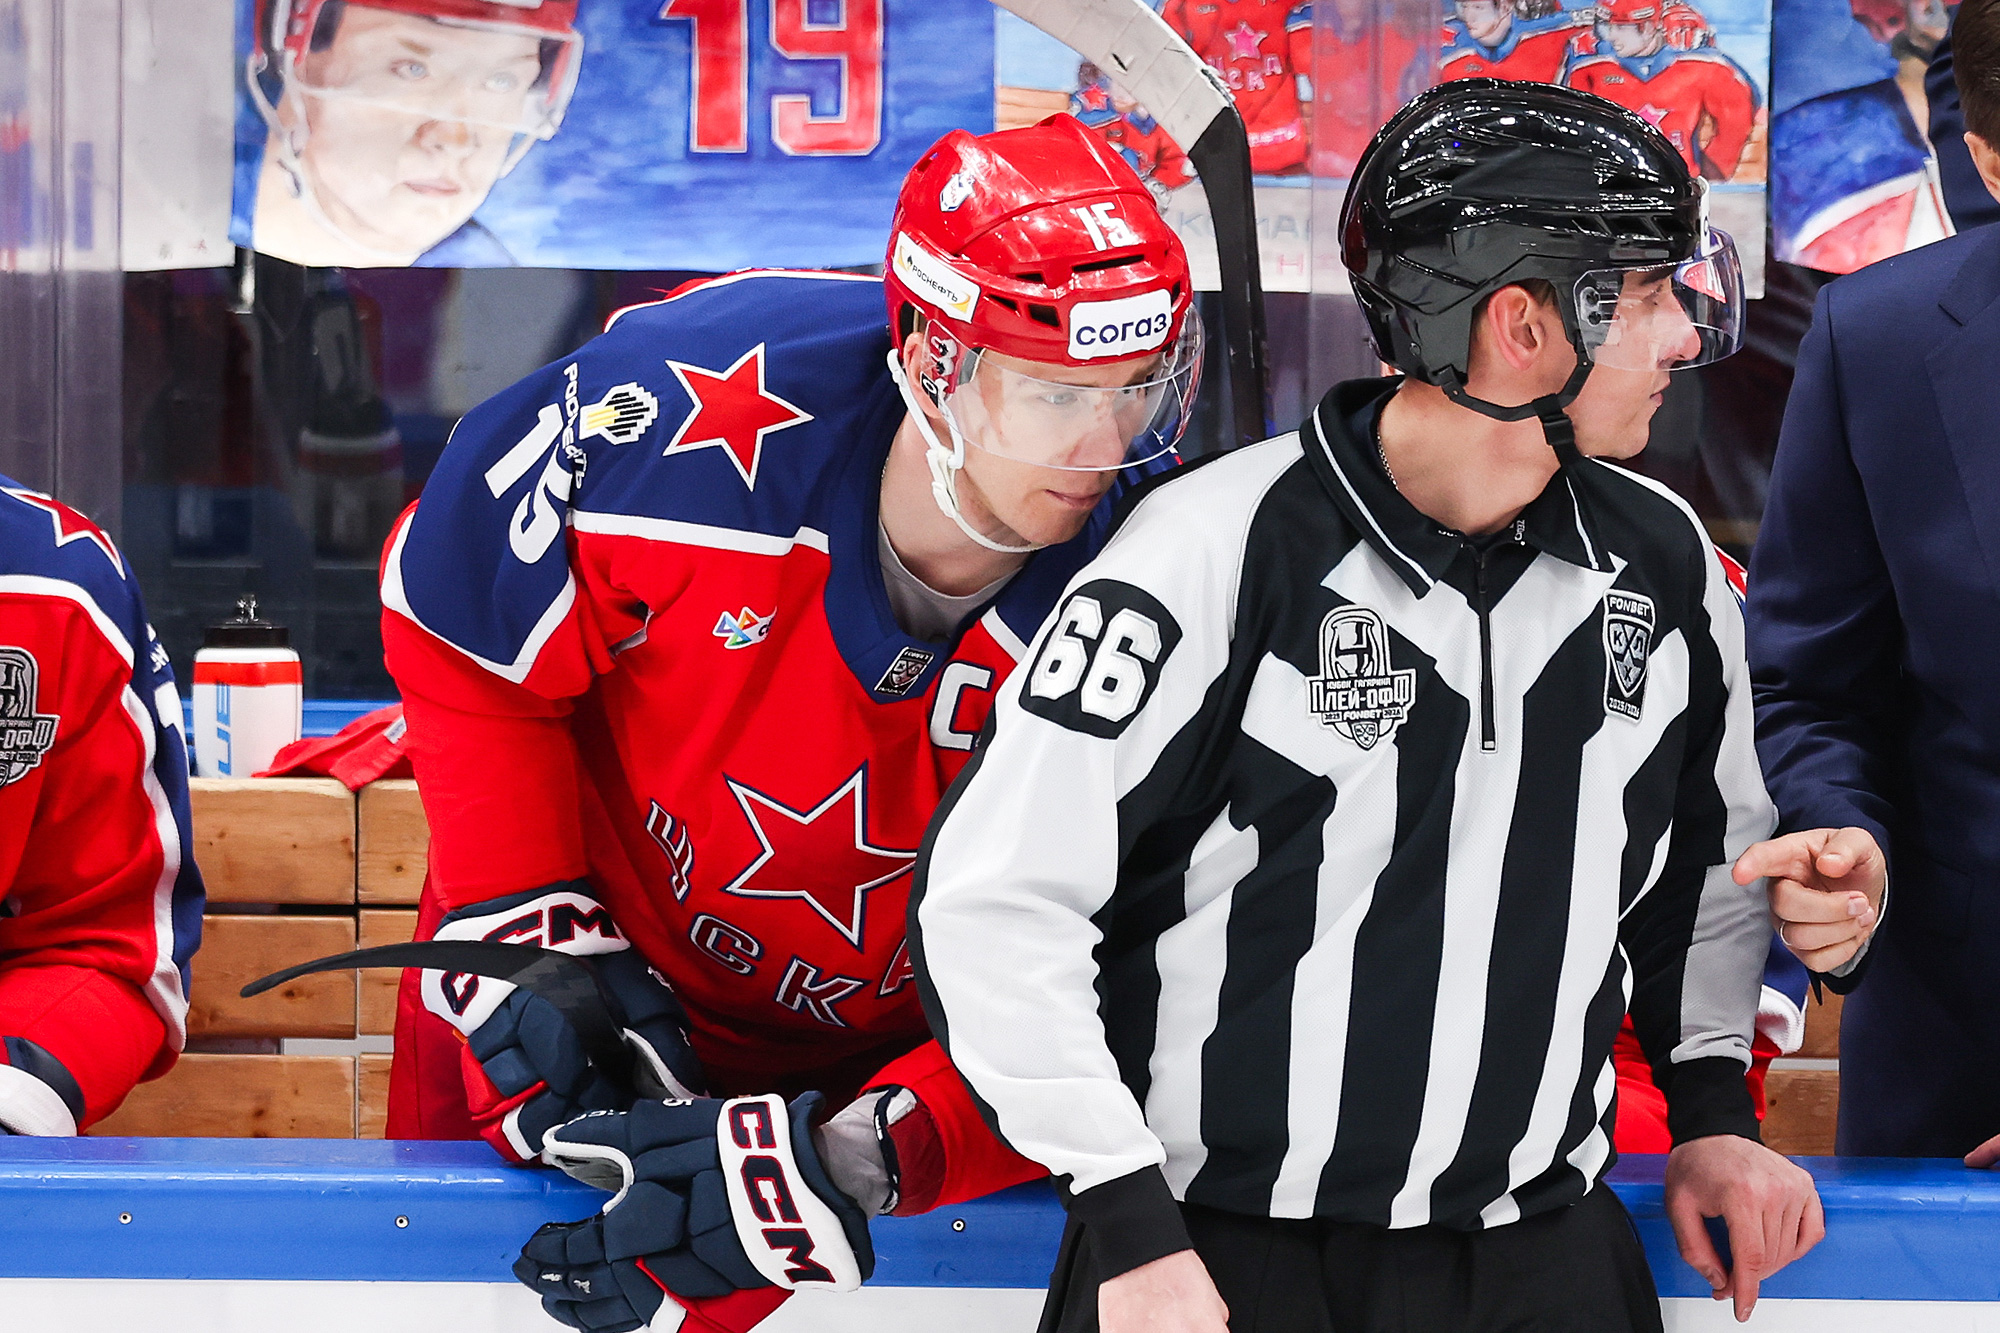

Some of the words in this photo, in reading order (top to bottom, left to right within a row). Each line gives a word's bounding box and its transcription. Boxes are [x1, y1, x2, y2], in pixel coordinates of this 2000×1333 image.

[660, 0, 885, 156] 19
[1072, 201, 1142, 251] 15
[911, 262, 959, 303] РОСНЕФТЬ
[484, 402, 573, 565] 15
[1609, 596, 1650, 616] FONBET
[1030, 595, 1163, 720] 66
[1326, 680, 1351, 690] КУБОК
[1343, 709, 1381, 720] FONBET
[728, 1101, 836, 1284] CCM
